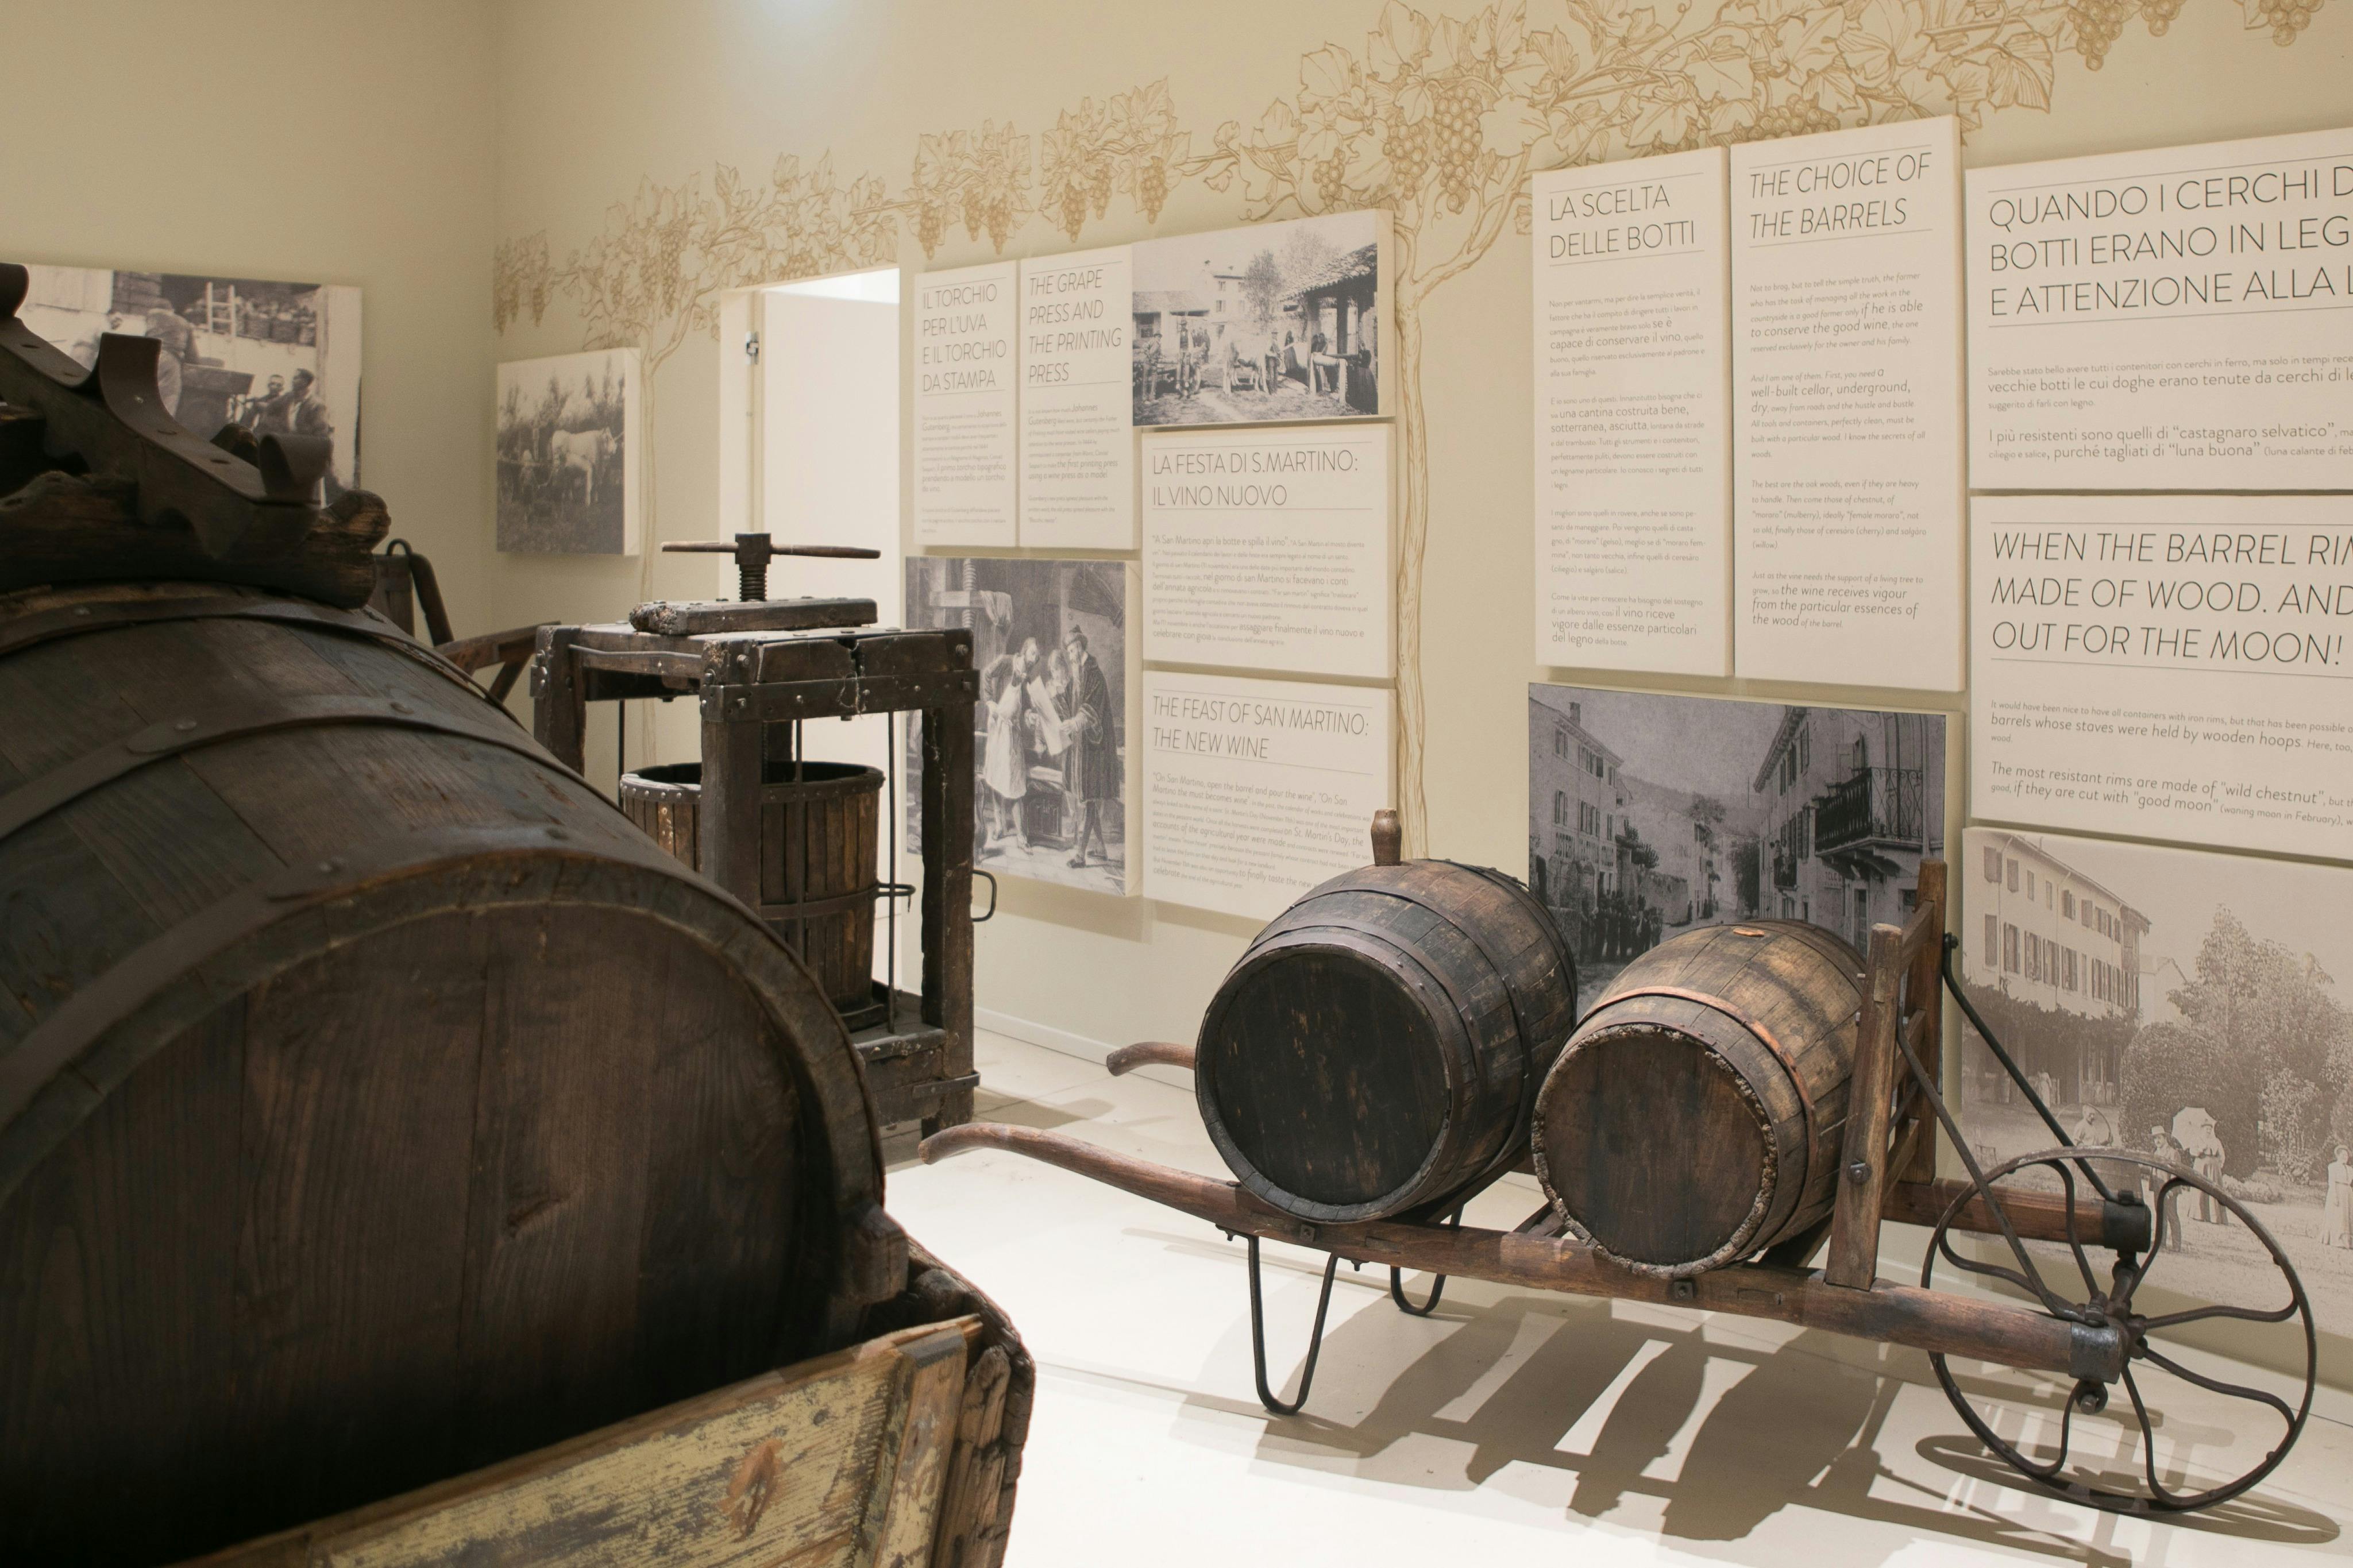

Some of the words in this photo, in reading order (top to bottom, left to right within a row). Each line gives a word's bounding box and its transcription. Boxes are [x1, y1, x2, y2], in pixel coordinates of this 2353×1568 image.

[1750, 169, 1790, 198] THE
[1797, 157, 1889, 193] CHOICE
[1896, 152, 1931, 181] OF
[1550, 196, 1576, 221] LA
[1583, 184, 1670, 217] SCELTA
[1990, 186, 2147, 233] QUANDO
[2161, 184, 2163, 212] I
[2177, 169, 2317, 210] CERCHI
[1751, 210, 1793, 238] THE
[1800, 198, 1906, 234] BARRELS
[1551, 229, 1619, 258] DELLE
[1628, 221, 1694, 250] BOTTI
[1992, 238, 2077, 271] BOTTI
[2092, 227, 2217, 264] ERANO
[2231, 223, 2263, 253] IN
[1030, 275, 1054, 295] THE
[1058, 269, 1103, 292] GRAPE
[1992, 288, 2007, 315] E
[2017, 273, 2234, 315] ATTENZIONE
[2243, 267, 2335, 301] ALLA
[923, 293, 933, 309] IL
[935, 284, 997, 307] TORCHIO
[1029, 304, 1069, 325] PRESS
[1072, 300, 1104, 320] AND
[1861, 302, 1870, 319] if
[1871, 302, 1885, 314] he
[1888, 301, 1896, 313] is
[1899, 300, 1923, 313] able
[923, 318, 947, 336] PER
[950, 314, 987, 334] L'UVA
[1750, 329, 1762, 338] to
[1764, 326, 1810, 337] conserve
[1812, 321, 1830, 334] the
[1833, 319, 1861, 337] good
[1863, 318, 1890, 330] wine,
[923, 347, 929, 364] E
[934, 346, 943, 364] IL
[945, 339, 1006, 361] TORCHIO
[1029, 334, 1054, 353] THE
[1058, 327, 1121, 351] PRINTING
[1550, 336, 1583, 352] capace
[1585, 335, 1594, 347] di
[1595, 335, 1650, 347] conservare
[1652, 331, 1657, 343] il
[1660, 331, 1683, 342] vino,
[923, 374, 941, 392] DA
[944, 370, 996, 390] STAMPA
[1029, 362, 1069, 383] PRESS
[1988, 379, 2036, 393] vecchie
[2040, 377, 2070, 391] botti
[2074, 376, 2085, 390] le
[2089, 376, 2108, 389] cui
[2112, 374, 2155, 392] doghe
[2158, 377, 2198, 388] erano
[2202, 374, 2251, 386] tenute
[2254, 370, 2271, 384] da
[2276, 369, 2323, 384] cerchi
[2328, 368, 2341, 382] di
[1751, 384, 1798, 397] well-built
[1801, 383, 1833, 397] cellar,
[1836, 380, 1911, 397] underground,
[1559, 410, 1576, 419] una
[1578, 406, 1613, 418] cantina
[1615, 404, 1658, 417] costruita
[1661, 403, 1689, 416] bene,
[1988, 401, 2026, 412] suggerito
[2027, 400, 2035, 408] di
[2036, 399, 2051, 408] farli
[2070, 399, 2095, 410] legno.
[1989, 428, 1993, 442] I
[1997, 428, 2016, 447] più
[2019, 427, 2077, 442] resistenti
[2081, 431, 2113, 442] sono
[2116, 426, 2153, 445] quelli
[2156, 426, 2169, 439] di
[1154, 455, 1172, 474] LA
[1176, 454, 1225, 474] FESTA
[1230, 453, 1246, 473] DI
[1252, 450, 1357, 473] S.MARTINO:
[1154, 487, 1166, 506] IL
[1168, 485, 1213, 506] VINO
[1218, 485, 1287, 506] NUOVO
[1994, 532, 2086, 561] WHEN
[2097, 533, 2156, 562] THE
[2167, 534, 2296, 564] BARREL
[1991, 577, 2082, 606] MADE
[2092, 579, 2137, 607] OF
[2148, 581, 2266, 613] WOOD.
[1753, 613, 1769, 625] the
[1772, 615, 1800, 626] wood
[1800, 618, 1809, 629] of
[1809, 619, 1820, 627] the
[1822, 620, 1842, 628] barrel.
[1993, 621, 2057, 650] OUT
[2065, 624, 2130, 654] FOR
[2141, 627, 2201, 658] THE
[2210, 631, 2342, 665] MOON!
[1154, 696, 1179, 717] THE
[1183, 698, 1225, 721] FEAST
[1229, 702, 1251, 723] OF
[1255, 704, 1285, 727] SAN
[1154, 727, 1181, 749] THE
[1186, 731, 1222, 752] NEW
[1227, 735, 1269, 759] WINE
[1991, 712, 2031, 728] barrels
[2035, 716, 2072, 731] whose
[2076, 721, 2114, 734] staves
[2117, 725, 2148, 736] were
[2151, 724, 2180, 739] held
[2182, 726, 2199, 744] by
[2202, 730, 2255, 744] wooden
[2259, 732, 2303, 751] hoops.
[1992, 760, 2012, 776] The
[2015, 767, 2046, 781] most
[2049, 768, 2103, 783] resistant
[2105, 772, 2132, 787] rims
[2136, 778, 2158, 789] are
[2161, 778, 2198, 793] made
[2201, 780, 2218, 798] of
[1991, 783, 2012, 794] good,
[2013, 780, 2024, 798] if
[2026, 781, 2053, 801] they
[2055, 788, 2075, 799] are
[2078, 790, 2099, 801] cut
[2103, 789, 2129, 804] with
[1152, 821, 1179, 831] accounts
[1181, 823, 1188, 834] of
[1189, 825, 1198, 834] the
[1199, 828, 1235, 840] agricultural
[1236, 834, 1250, 843] year
[1251, 836, 1266, 844] were
[1267, 837, 1286, 847] made
